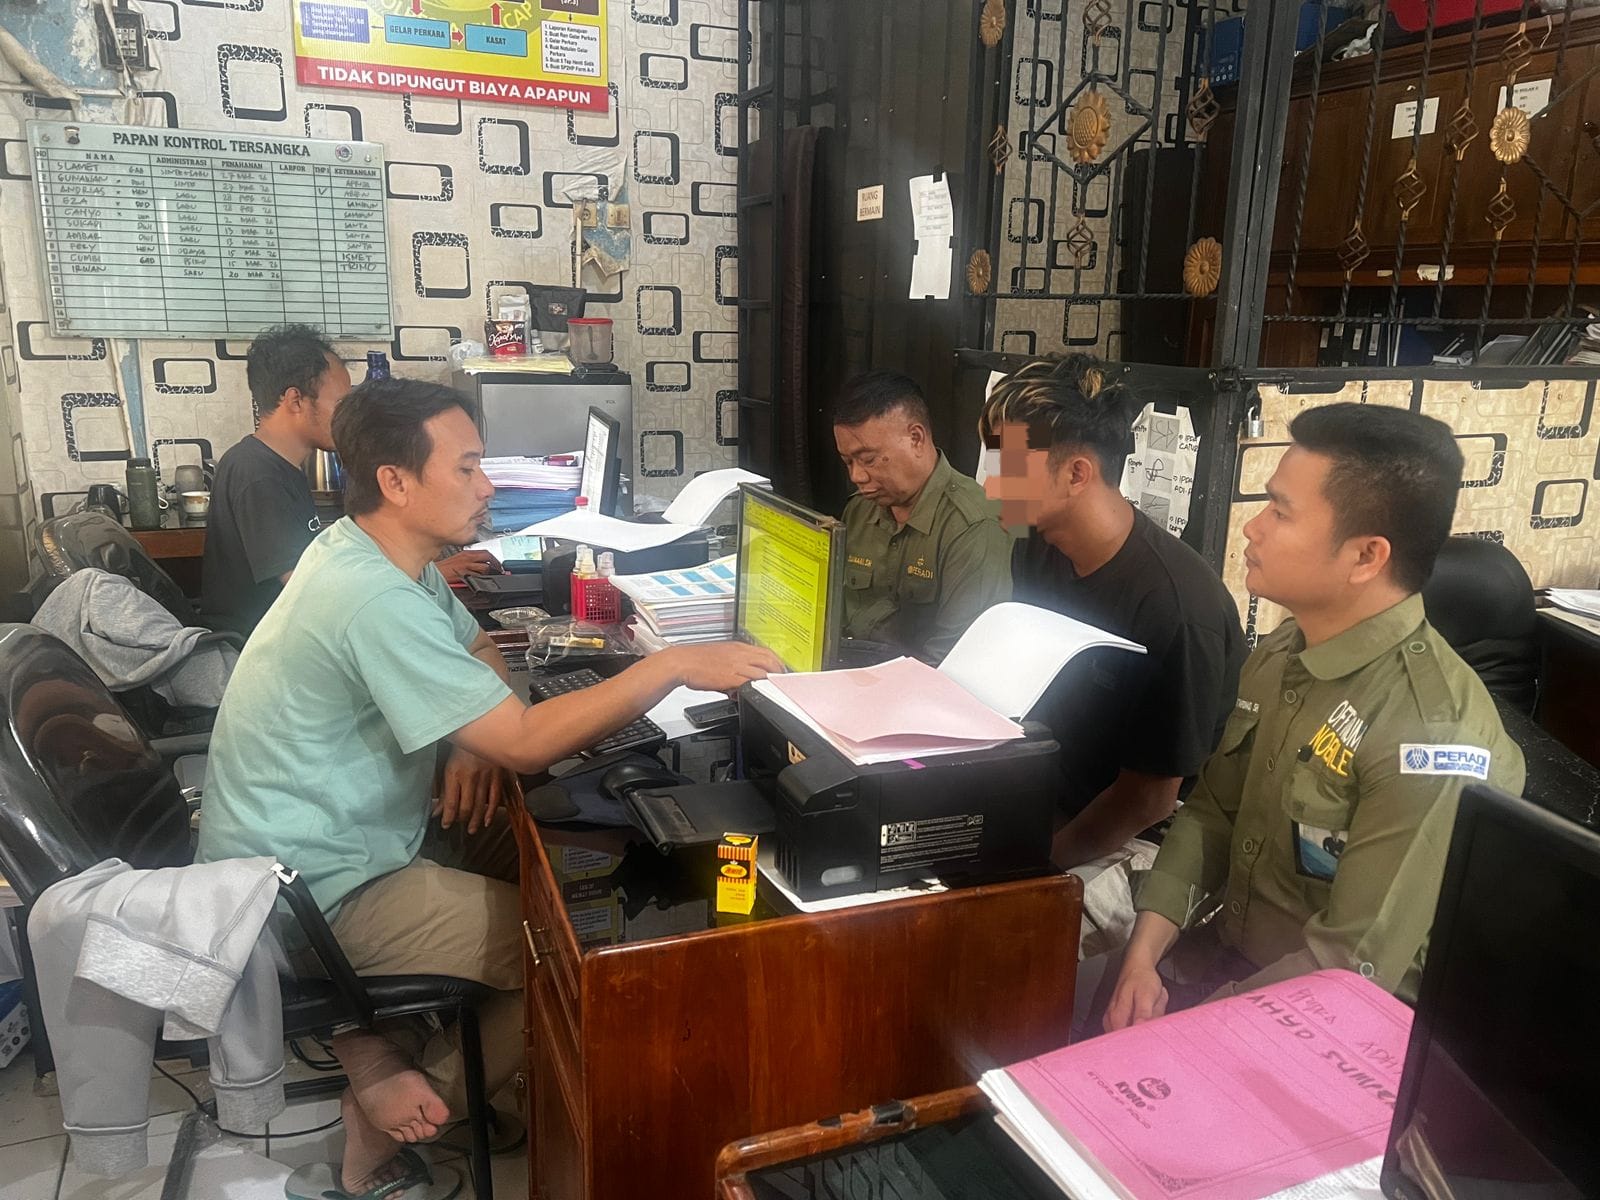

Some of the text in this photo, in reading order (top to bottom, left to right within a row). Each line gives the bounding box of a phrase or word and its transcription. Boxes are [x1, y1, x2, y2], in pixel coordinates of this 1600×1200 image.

[390, 25, 446, 39] GELAR PERKARA
[486, 36, 507, 45] KASAT
[318, 66, 591, 105] TIDAK DIPUNGUT BIAYA APAPUN
[113, 132, 311, 157] PAPAN KONTROL TERSANGKA
[36, 150, 47, 158] NO
[86, 153, 115, 161] NAMA
[156, 157, 207, 166] ADMINISTRASI
[221, 162, 263, 170] PENAHANAN
[280, 164, 306, 172] LABFOR
[334, 168, 377, 176] KETERANGAN
[57, 161, 99, 172] SLAMET
[862, 190, 879, 202] RUANG
[860, 206, 881, 217] BERMAIN
[72, 265, 107, 273] IRWAN
